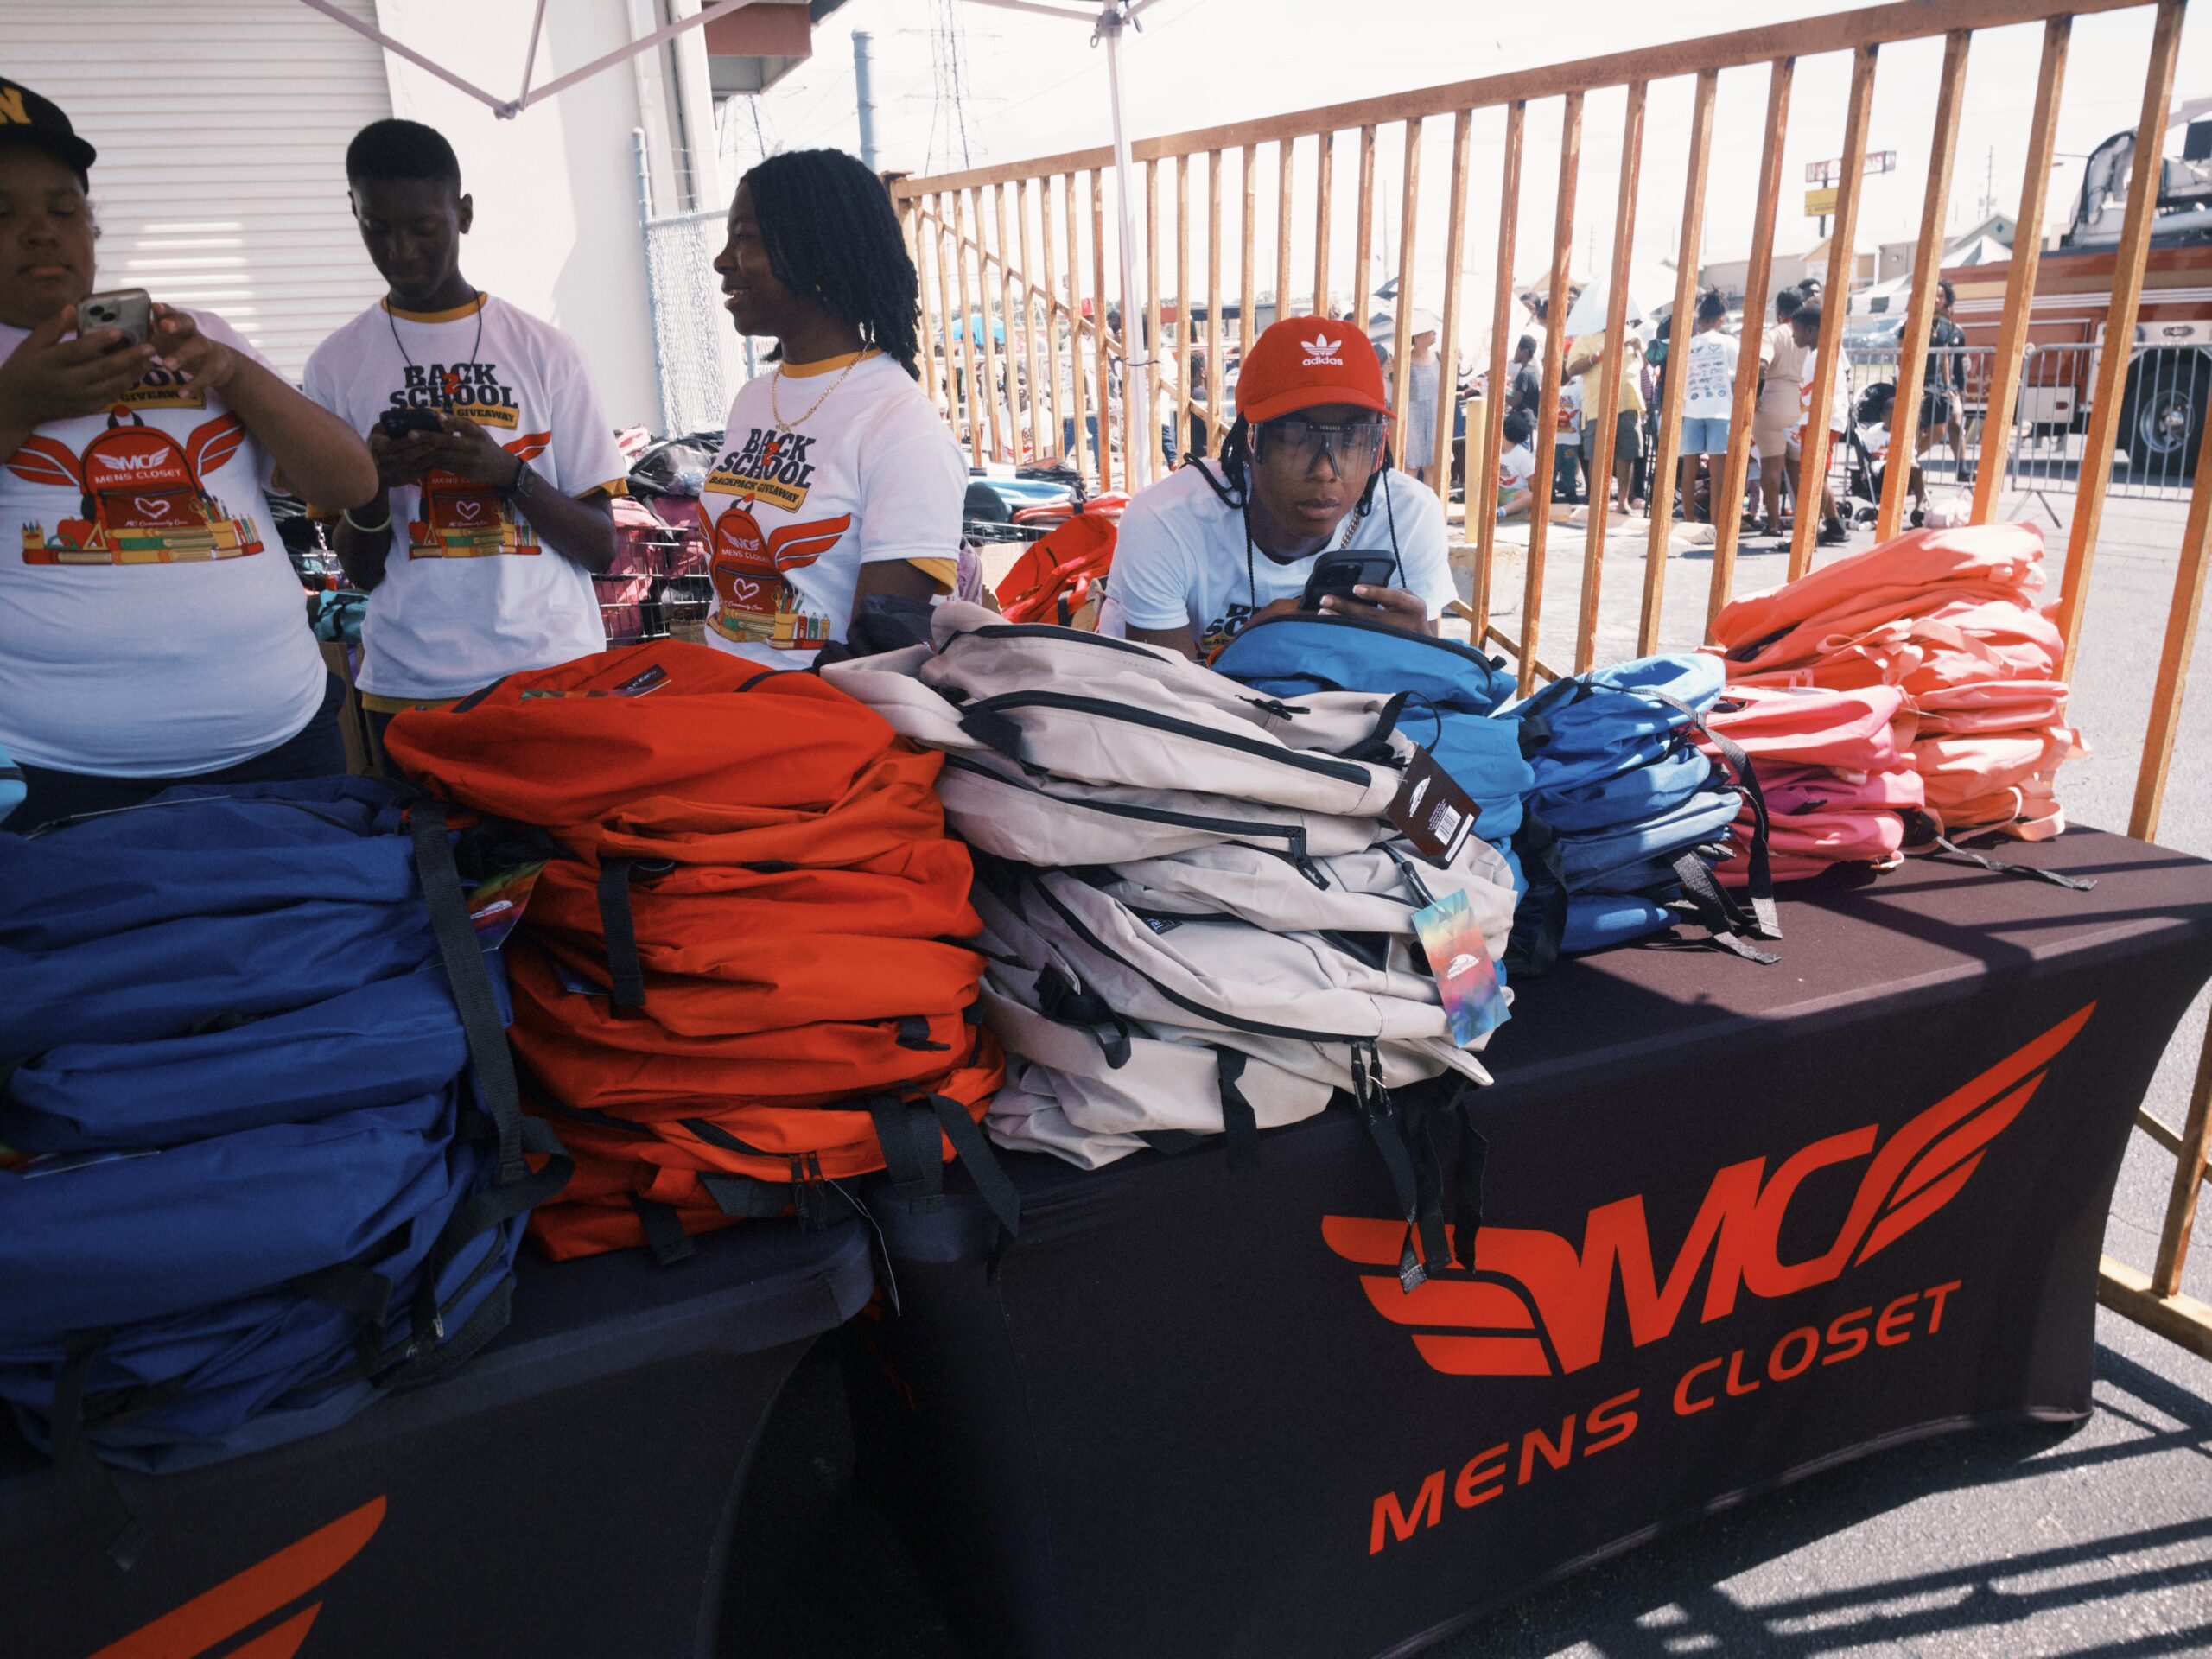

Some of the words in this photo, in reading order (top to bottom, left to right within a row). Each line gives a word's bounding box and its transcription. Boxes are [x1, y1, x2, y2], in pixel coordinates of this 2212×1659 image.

[1302, 356, 1343, 366] adidas
[404, 363, 499, 388] BACK
[442, 373, 460, 394] 2
[390, 385, 518, 410] SCHOOL
[457, 409, 514, 422] GIVEAWAY
[741, 429, 817, 462] BACK
[762, 442, 780, 465] 2
[94, 471, 133, 484] MENS
[136, 468, 182, 480] CLOSET
[716, 452, 816, 489] SCHOOL
[709, 476, 758, 491] BACKPACK
[757, 483, 799, 502] GIVEAWAY
[721, 549, 743, 558] MENS
[1369, 1387, 1640, 1556] MENS
[1673, 1280, 1962, 1416] CLOSET
